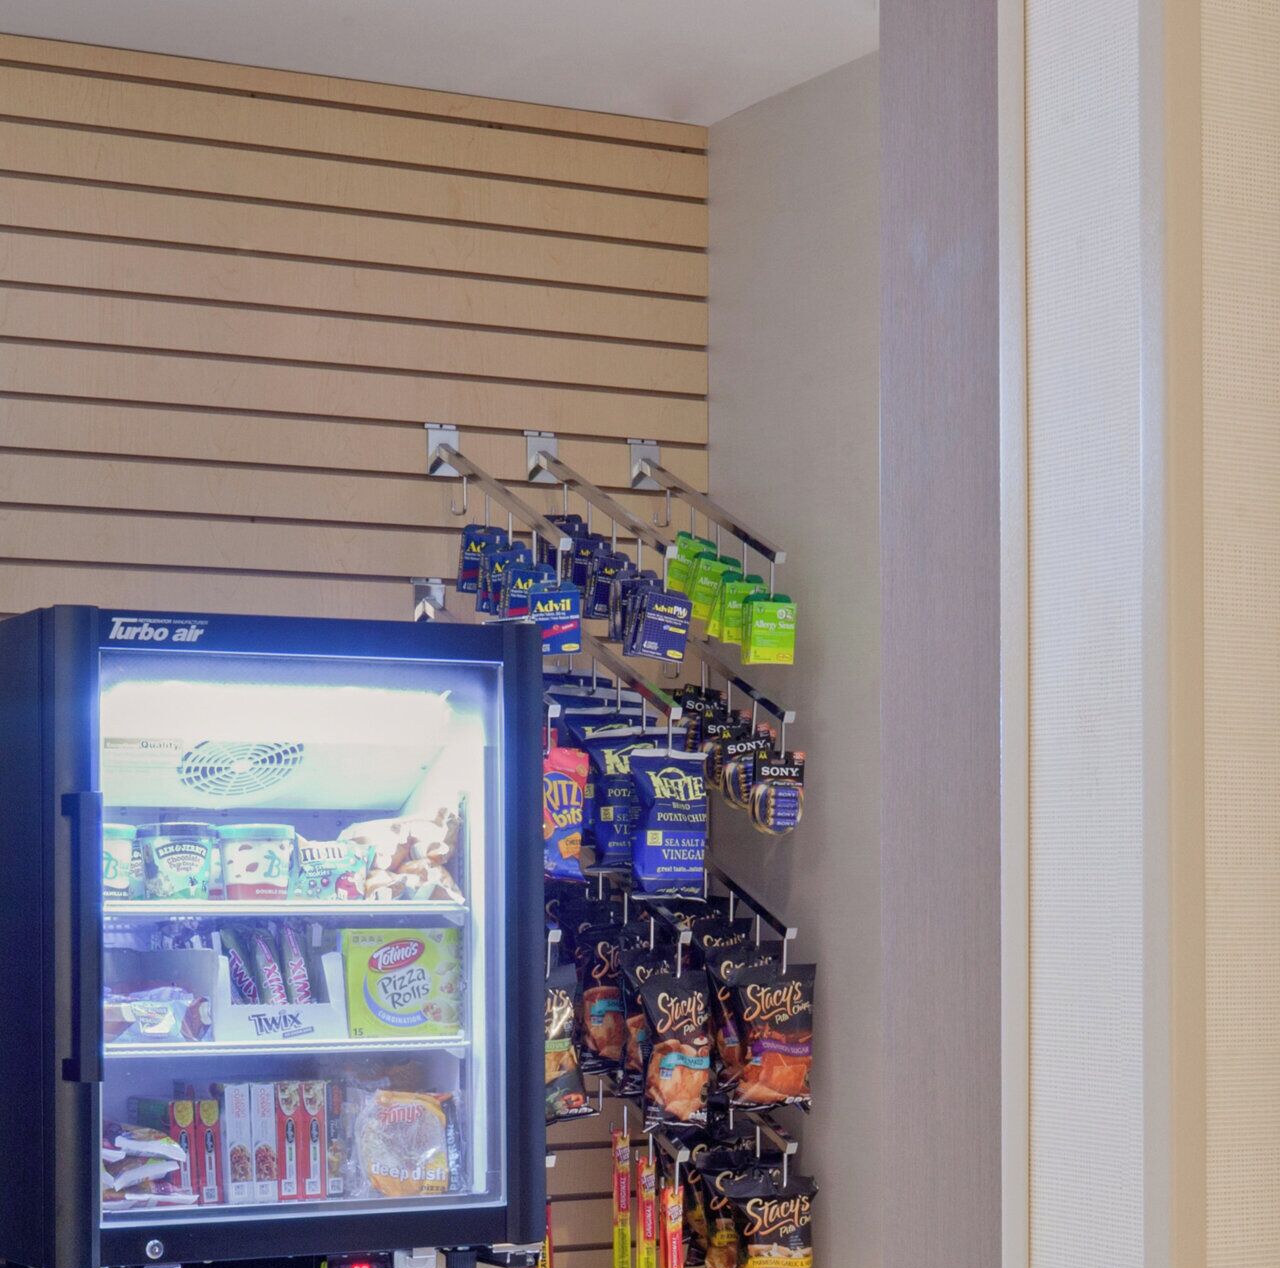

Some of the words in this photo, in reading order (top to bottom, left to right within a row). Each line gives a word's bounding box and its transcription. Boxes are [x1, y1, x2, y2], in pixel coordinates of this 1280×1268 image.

[534, 599, 572, 613] Advil
[109, 617, 169, 641] Turbo
[172, 625, 204, 642] air
[727, 739, 766, 754] SONY
[646, 767, 706, 801] KETTLE
[761, 766, 800, 777] SONY
[553, 807, 583, 827] bits
[657, 813, 687, 821] POTATO
[664, 839, 680, 847] SEA
[681, 839, 699, 847] SALT
[373, 940, 419, 970] Totino's
[228, 949, 259, 1005] TWIX
[377, 968, 426, 994] Pizza
[386, 983, 430, 1010] Rolls
[743, 981, 803, 1022] Stacy's
[657, 991, 705, 1034] Stacy's
[353, 1028, 364, 1036] 15
[372, 1162, 409, 1181] deep
[412, 1161, 446, 1181] dish
[743, 1194, 810, 1236] Stacy's
